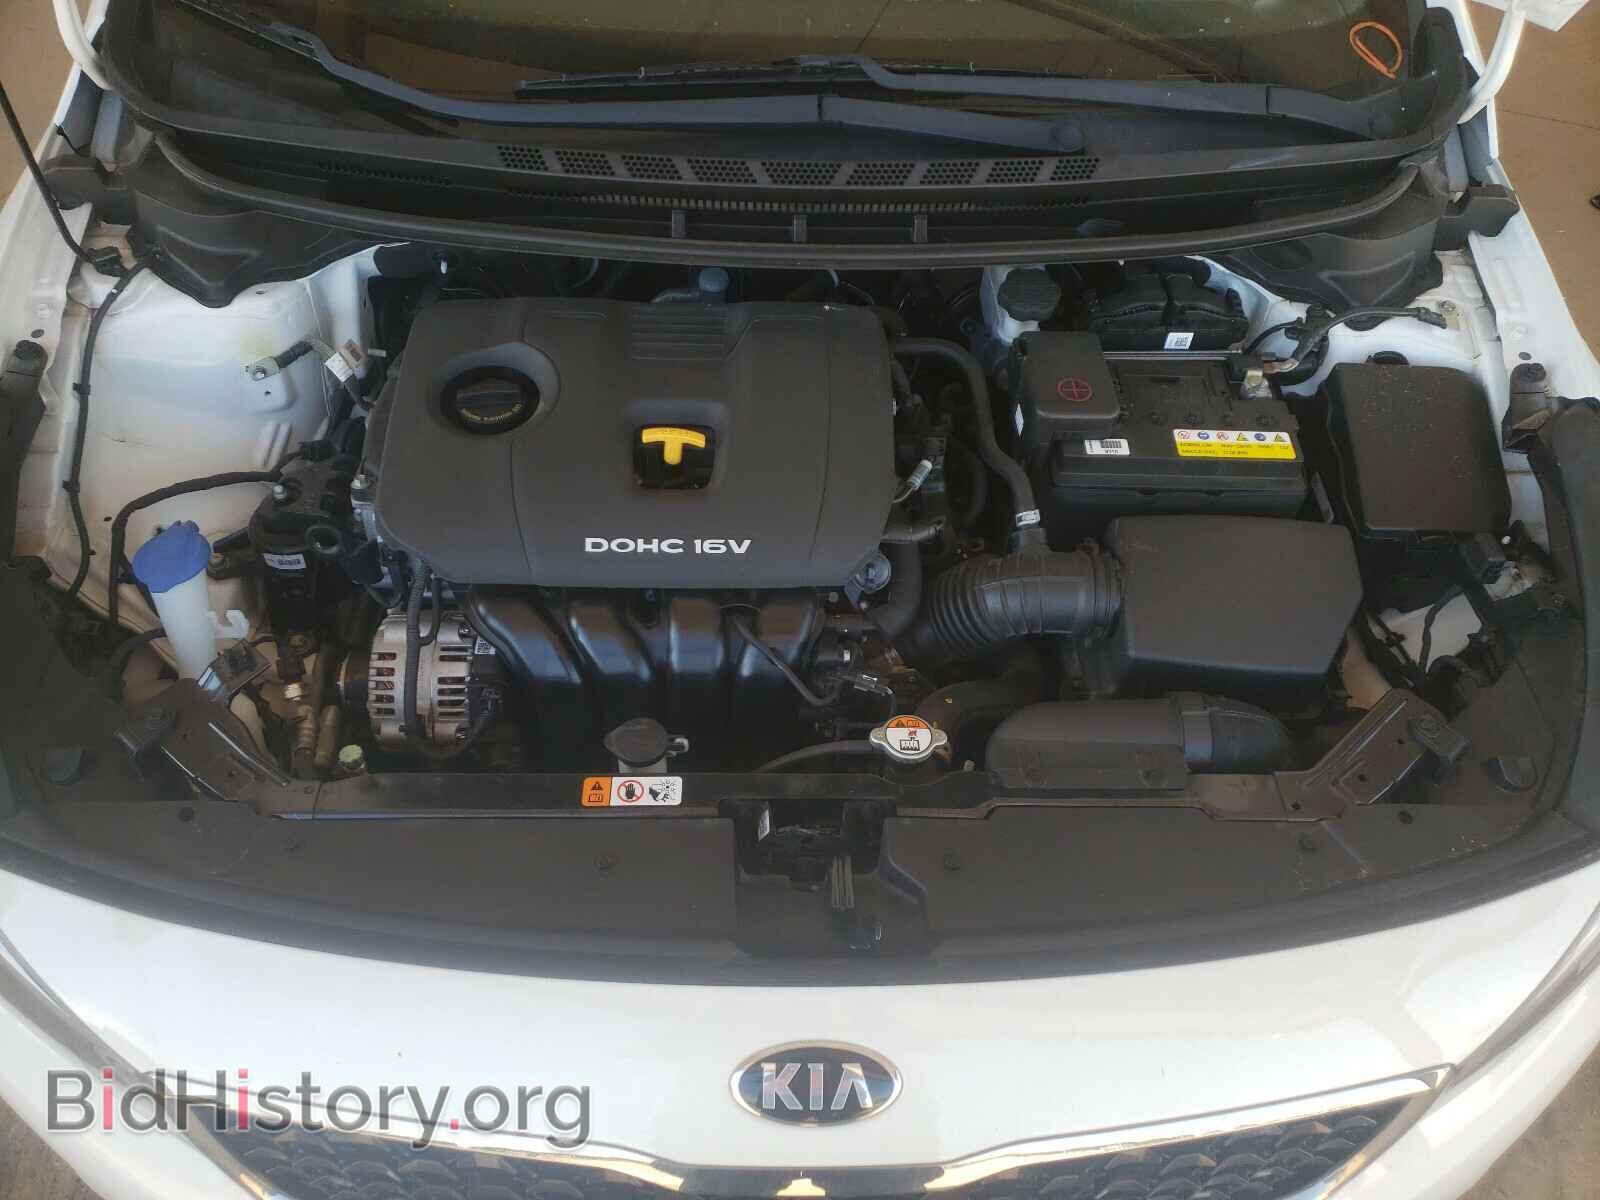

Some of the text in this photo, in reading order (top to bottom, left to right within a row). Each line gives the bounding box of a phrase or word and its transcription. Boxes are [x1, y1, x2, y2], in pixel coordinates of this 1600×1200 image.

[584, 537, 752, 554] DOHC 16V
[761, 1062, 873, 1110] KIA
